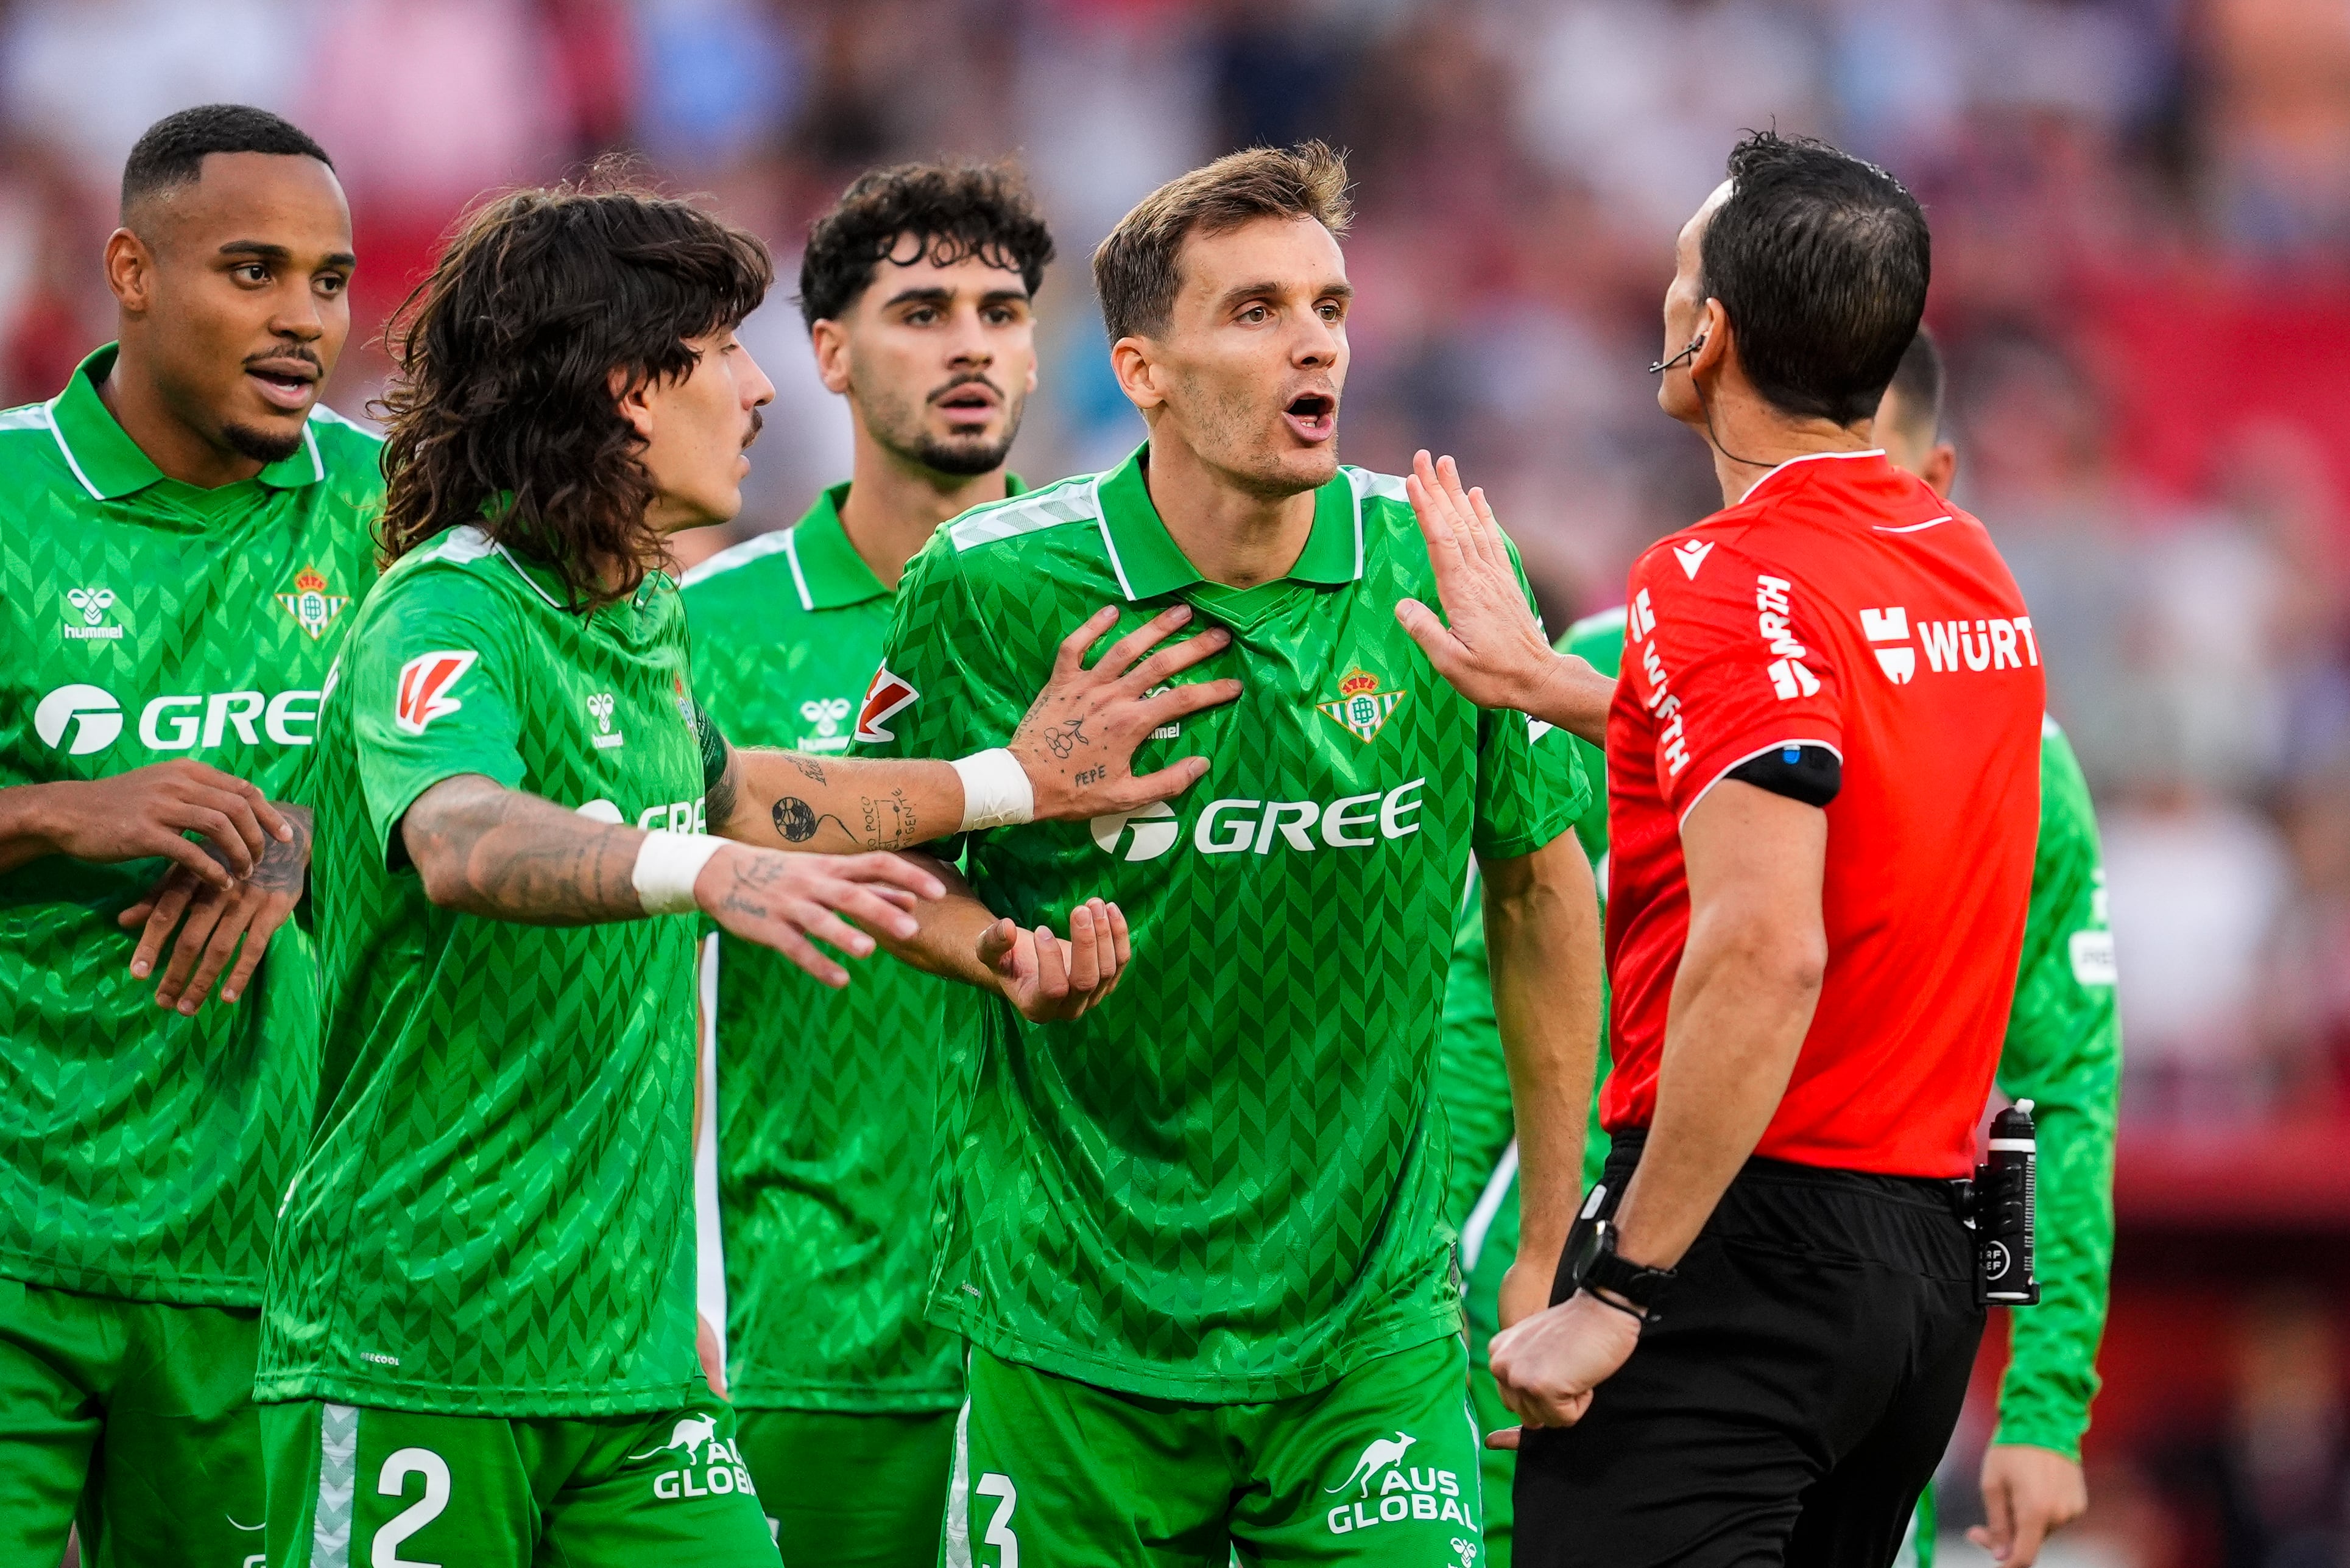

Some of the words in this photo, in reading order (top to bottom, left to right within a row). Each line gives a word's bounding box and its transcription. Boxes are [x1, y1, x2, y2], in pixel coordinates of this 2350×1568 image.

[64, 623, 123, 639] hummel
[1756, 574, 1807, 659] WRTH
[1916, 616, 2039, 673] WÜRT
[1074, 764, 1106, 788] PEPE
[861, 796, 877, 832] POCO
[1194, 777, 1425, 854] GREE
[707, 1438, 747, 1467] AU
[1380, 1467, 1459, 1497] AUS
[371, 1447, 451, 1568] 2
[975, 1472, 1018, 1568] 3
[1327, 1493, 1478, 1534] GLOBAL
